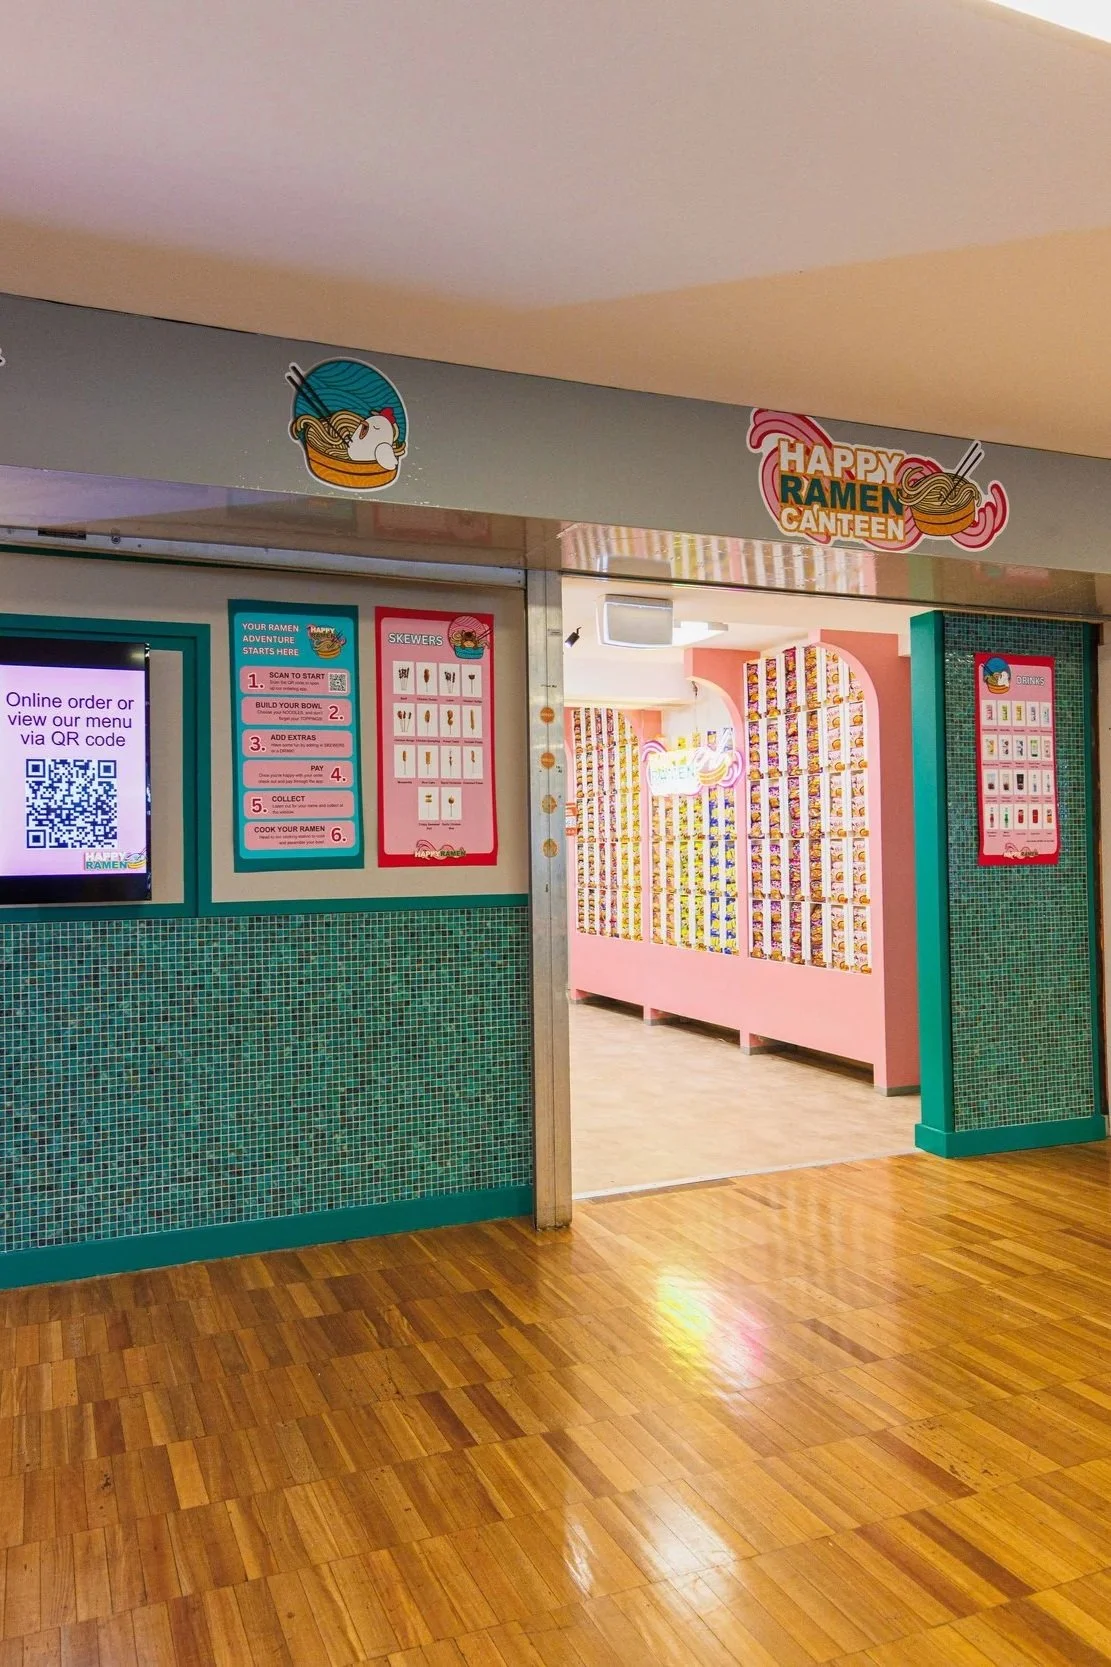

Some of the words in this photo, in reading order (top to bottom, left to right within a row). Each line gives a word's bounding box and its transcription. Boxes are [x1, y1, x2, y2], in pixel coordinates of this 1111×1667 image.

[779, 439, 904, 485] HAPPY
[779, 474, 903, 516] RAMEN
[779, 506, 905, 542] CANTEEN
[242, 623, 266, 631] YOUR
[268, 624, 299, 632] RAMEN
[310, 626, 335, 634] HAPPY
[242, 635, 295, 644] ADVENTURE
[388, 632, 443, 646] SKEWERS
[242, 647, 274, 656] STARTS
[276, 648, 299, 656] HERE
[248, 673, 264, 689] 1.
[1016, 675, 1045, 686] DRINKS
[6, 692, 63, 708] Online
[68, 695, 112, 710] order
[117, 698, 134, 710] or
[328, 705, 344, 720] 2.
[8, 712, 47, 727] view
[52, 716, 80, 727] our
[86, 717, 132, 728] menu
[20, 730, 45, 745] via
[51, 730, 80, 747] QR
[85, 732, 126, 747] code
[250, 736, 266, 752] 3.
[330, 768, 346, 782] 4.
[252, 798, 267, 813] 5.
[330, 828, 346, 842] 6.
[85, 851, 126, 862] HAPPY
[440, 848, 466, 857] RAMEN
[85, 860, 128, 870] RAMEN
